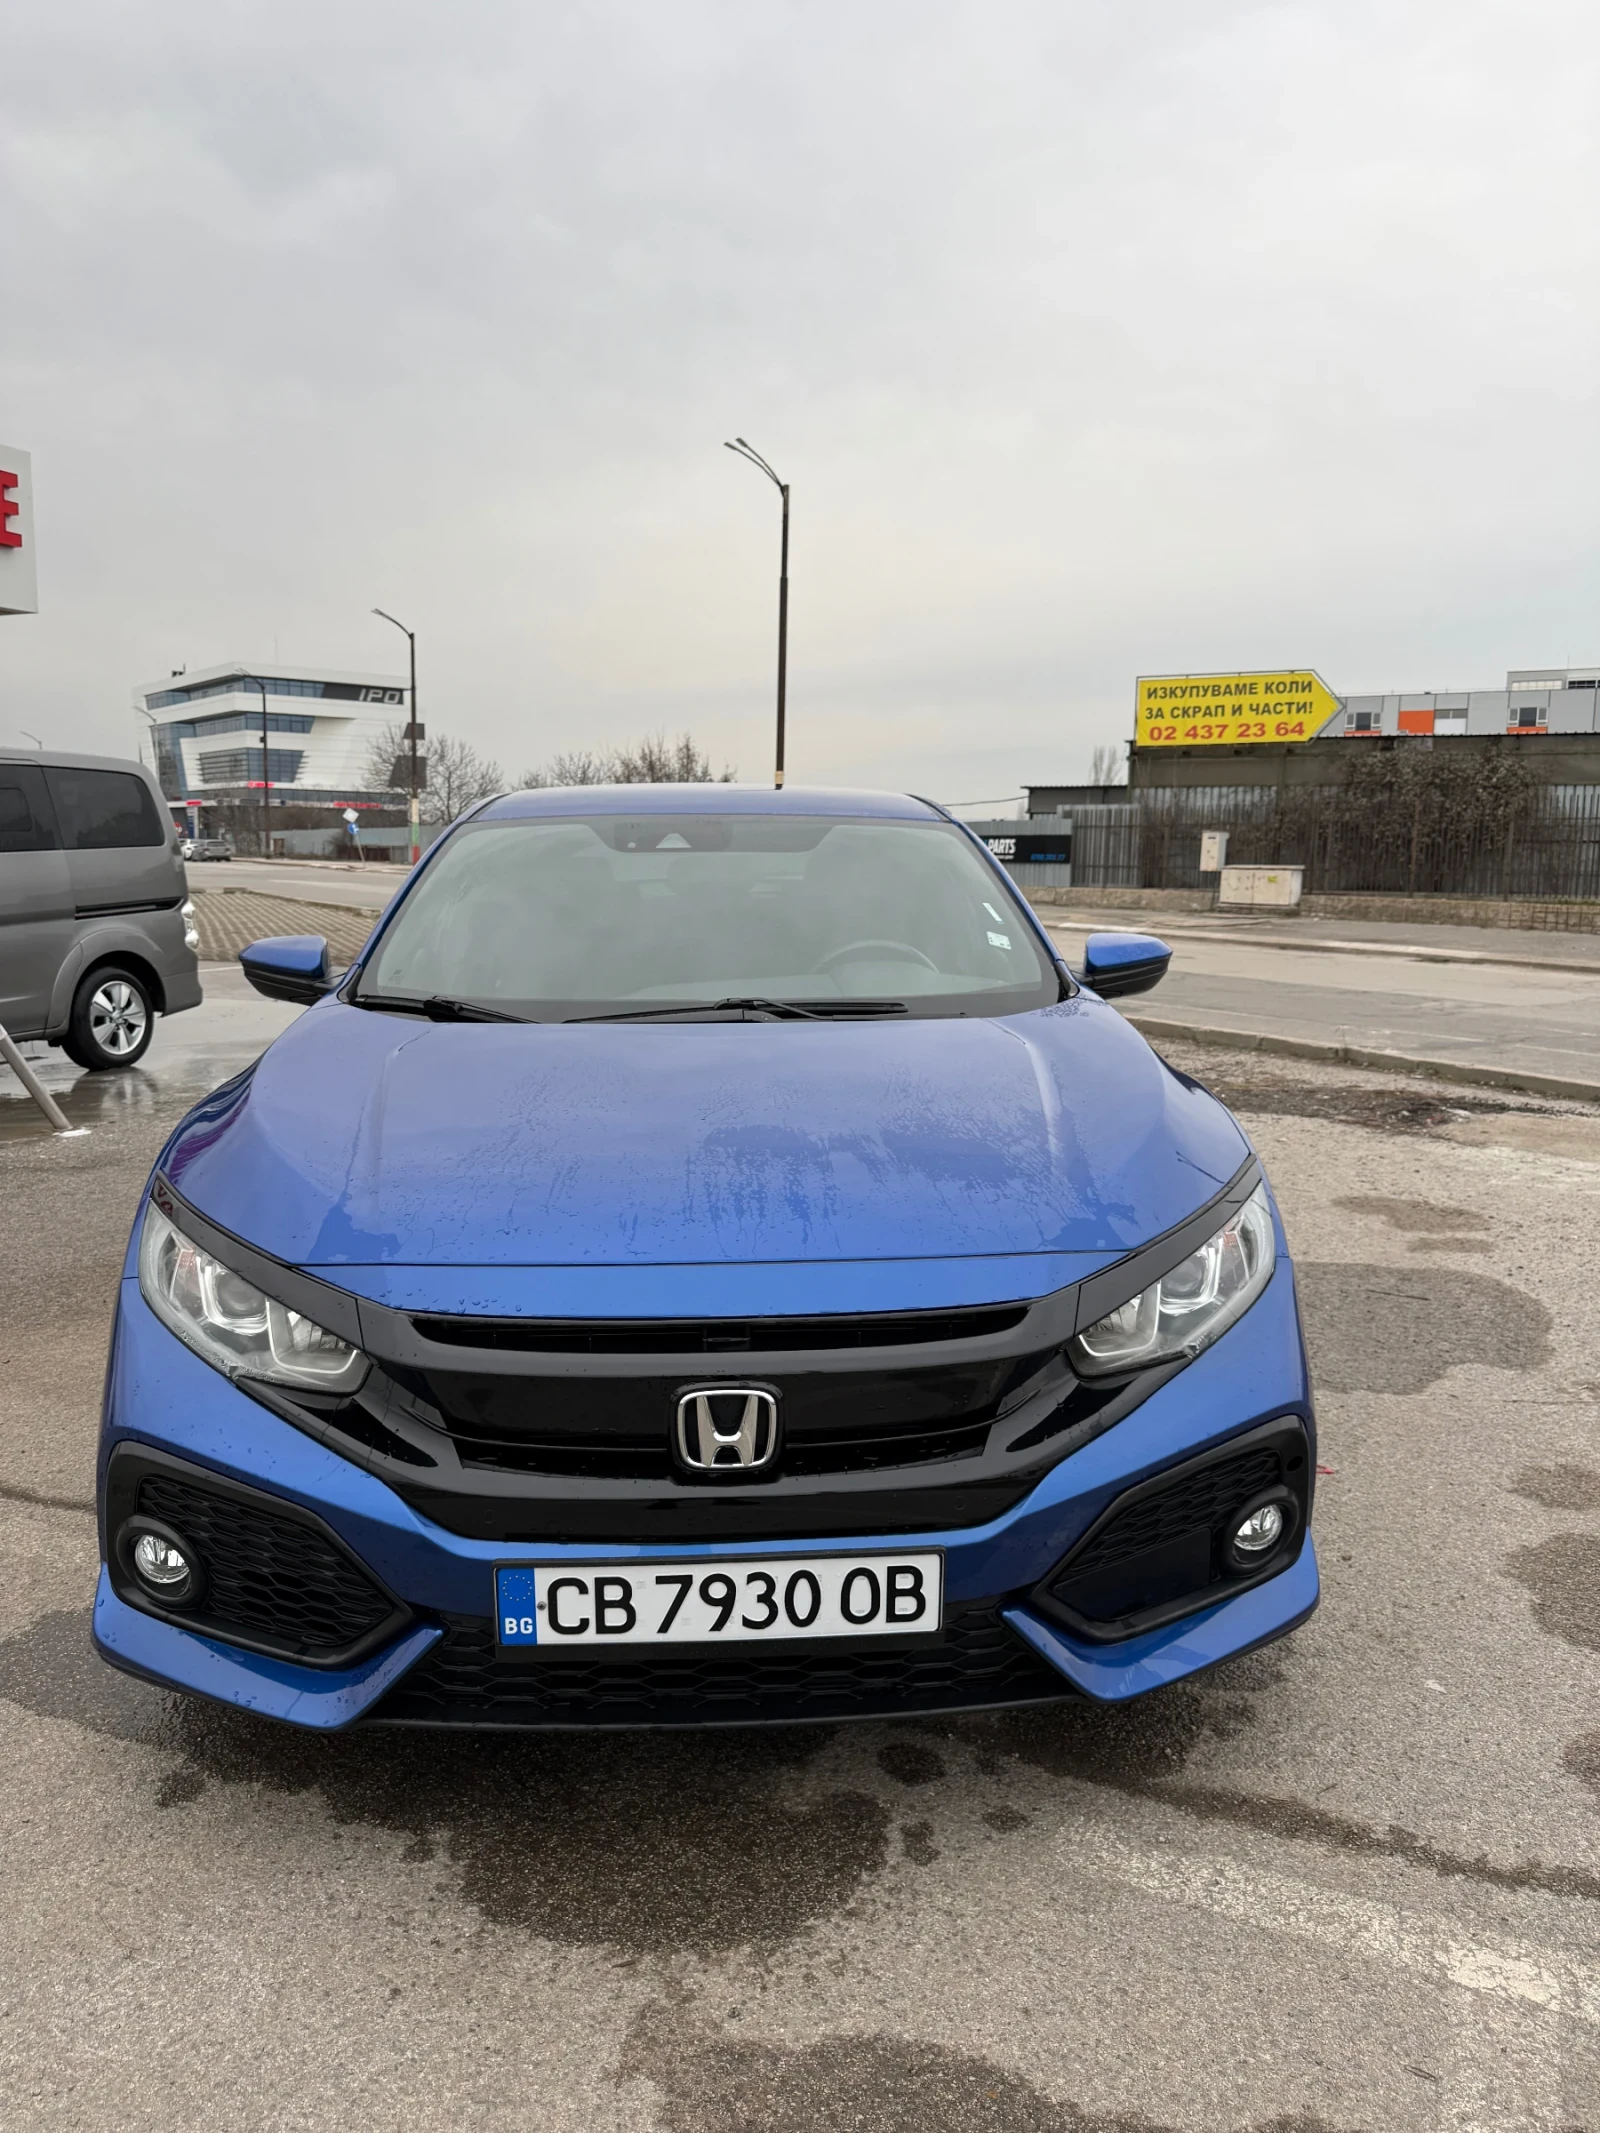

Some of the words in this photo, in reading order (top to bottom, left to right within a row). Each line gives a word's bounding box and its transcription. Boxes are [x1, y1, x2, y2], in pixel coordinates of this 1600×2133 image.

[358, 688, 401, 704] IPO
[1147, 683, 1258, 700] ИЗКУПУВАМЕ
[1264, 681, 1312, 695] КОЛИ
[1145, 707, 1165, 720] ЗА
[1170, 705, 1225, 719] СКРАП
[1231, 704, 1243, 717] И
[1249, 701, 1313, 716] ЧАСТИ!
[1149, 726, 1177, 741] 02
[1184, 724, 1229, 740] 437
[1237, 722, 1266, 738] 23
[1275, 721, 1305, 737] 64
[546, 1576, 637, 1635] CB
[654, 1569, 822, 1634] 7930
[504, 1616, 533, 1635] BG
